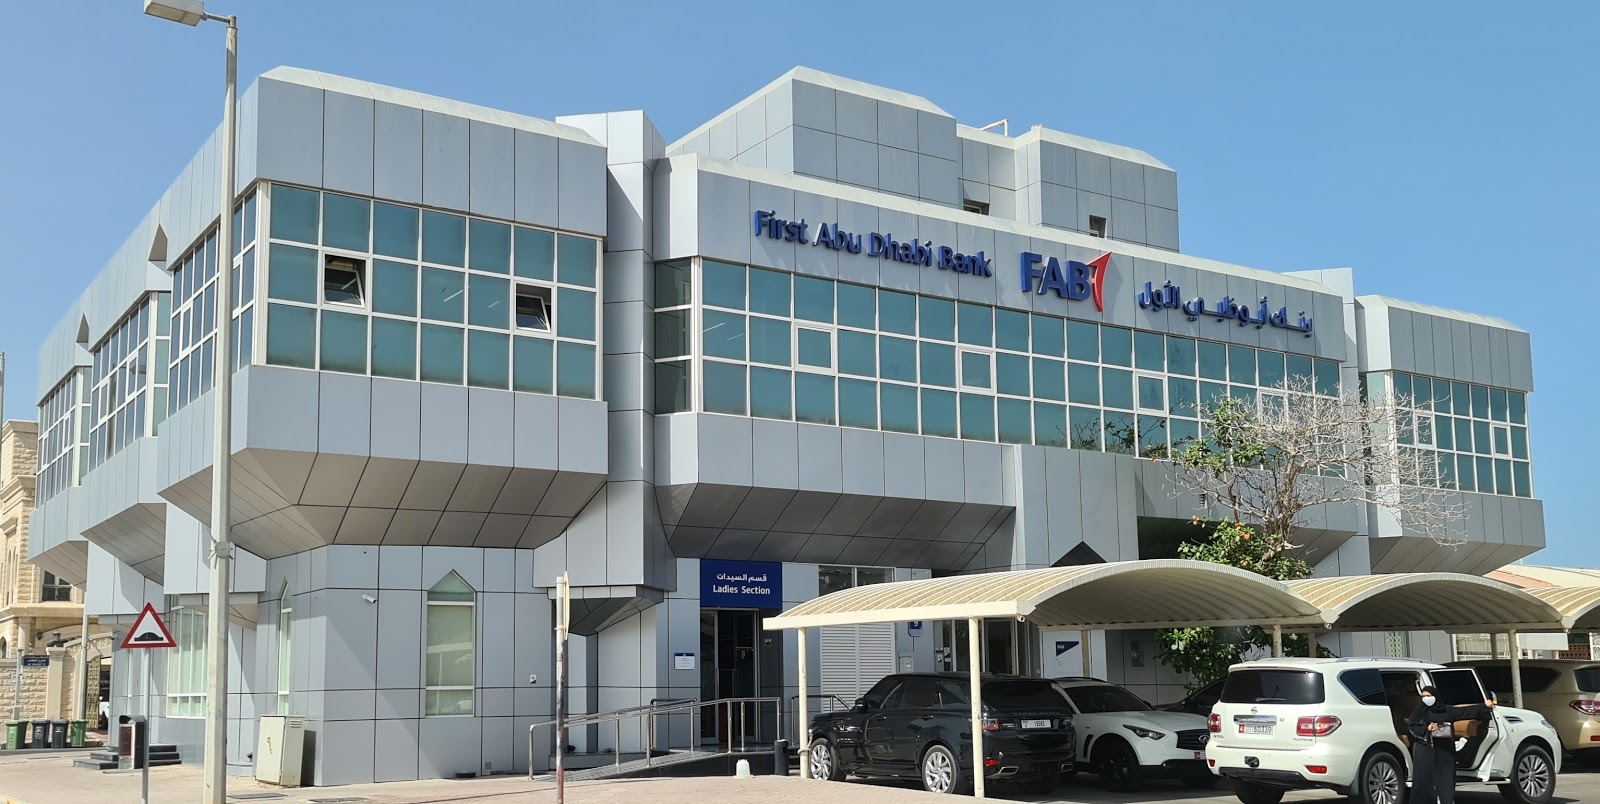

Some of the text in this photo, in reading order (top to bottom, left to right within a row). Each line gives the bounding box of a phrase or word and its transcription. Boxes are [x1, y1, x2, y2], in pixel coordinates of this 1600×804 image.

[754, 209, 993, 278] First Abu Dhabi Bank
[1020, 251, 1092, 301] FAB
[1137, 279, 1181, 312] الأول
[1269, 305, 1313, 338] بنك
[712, 584, 771, 595] Ladies Section
[716, 573, 767, 583] قسم السيدات
